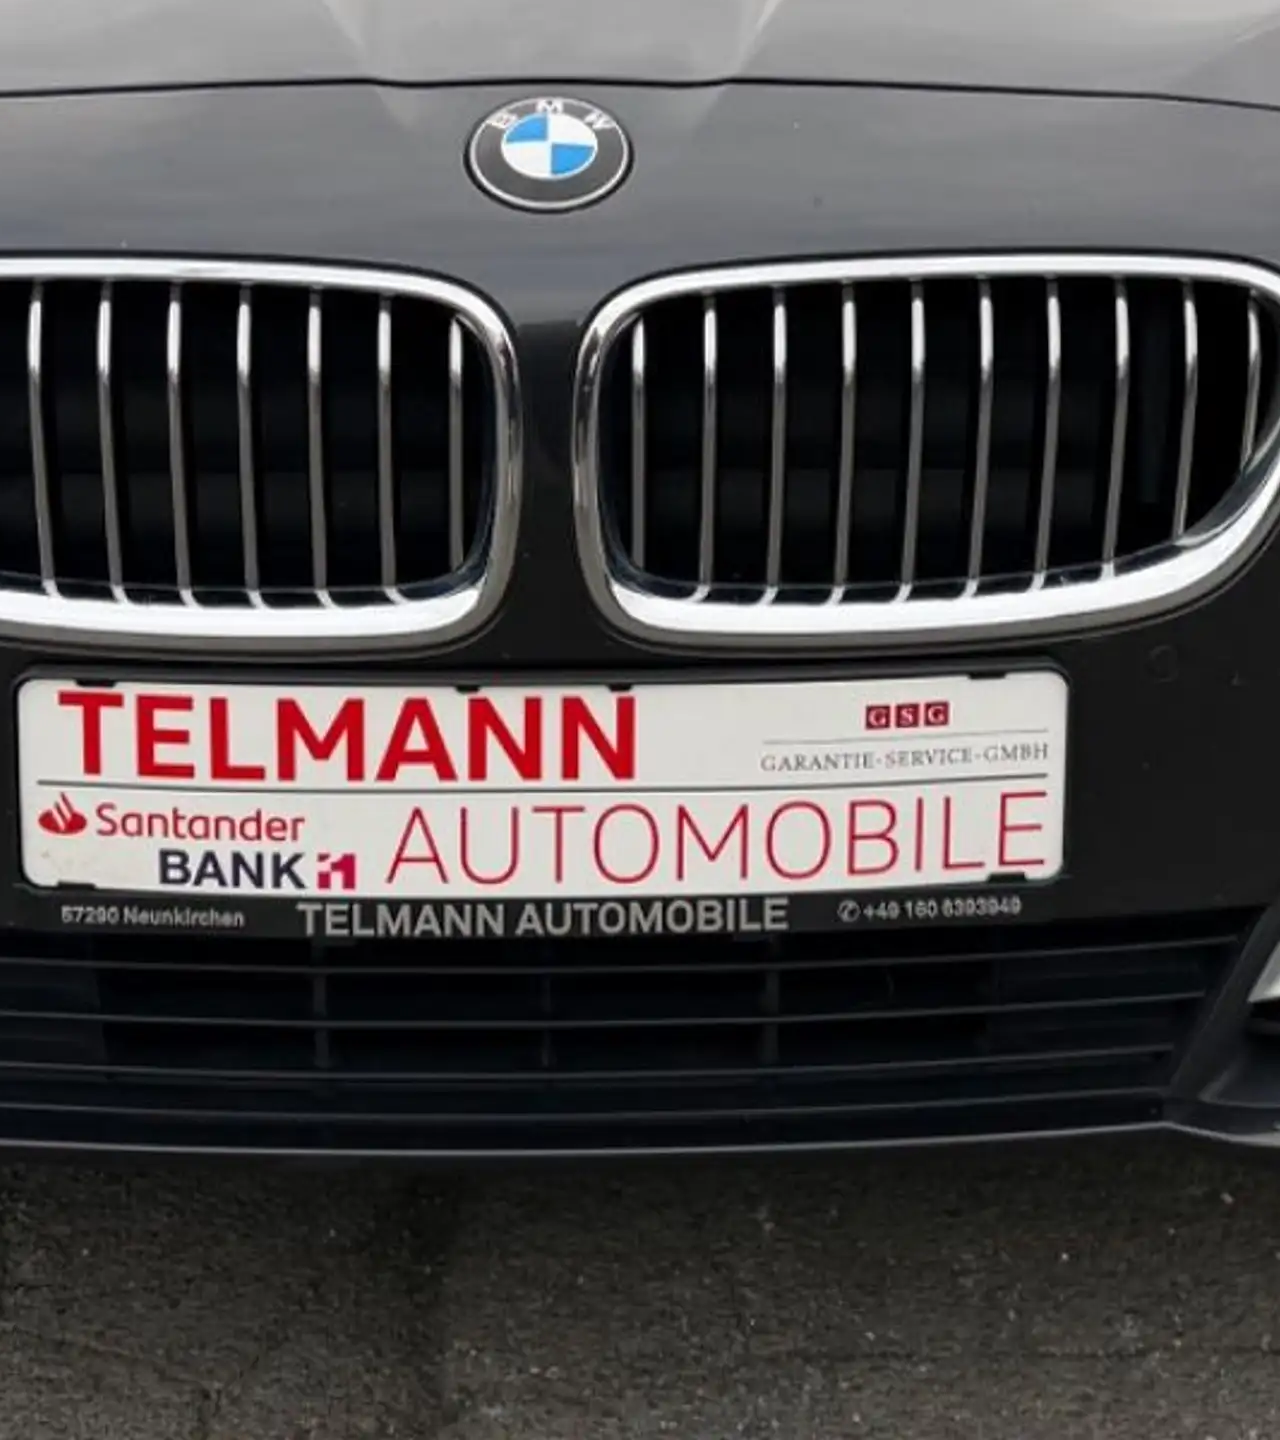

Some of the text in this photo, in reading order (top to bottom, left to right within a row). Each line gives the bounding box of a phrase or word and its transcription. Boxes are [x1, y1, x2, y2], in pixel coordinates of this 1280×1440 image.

[486, 98, 617, 130] BMW
[58, 691, 635, 782] TELMANN
[95, 802, 306, 841] Santander
[386, 790, 1048, 885] AUTOMOBILE
[158, 848, 307, 890] BANK
[123, 905, 245, 928] Neunkirchen
[296, 897, 789, 937] TELMANN AUTOMOBILE
